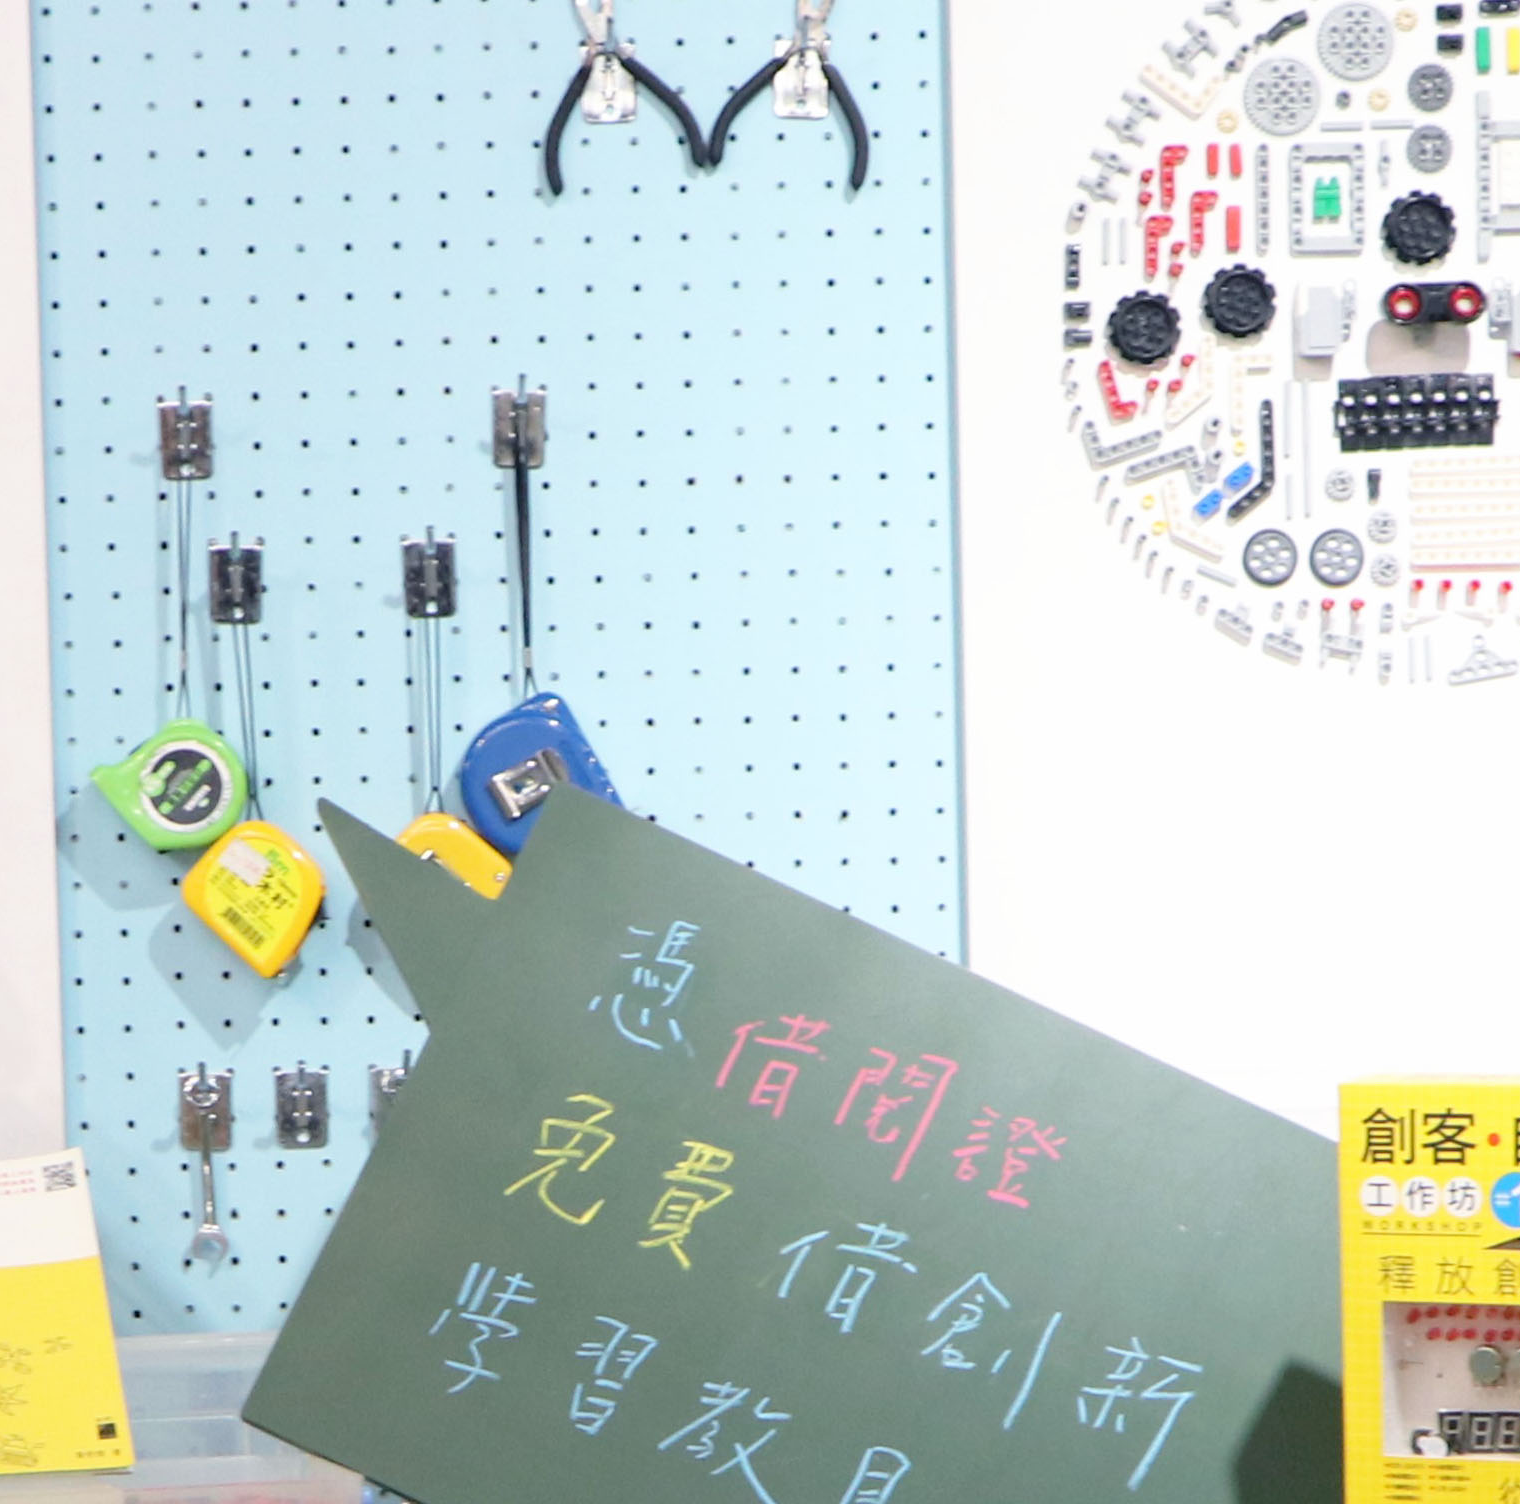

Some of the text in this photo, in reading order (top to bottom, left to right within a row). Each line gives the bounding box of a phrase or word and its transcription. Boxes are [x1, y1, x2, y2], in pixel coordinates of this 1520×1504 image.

[1365, 1181, 1478, 1213] 工作坊
[1362, 1219, 1483, 1233] WORKSHOP
[503, 1093, 1204, 1490] 免費借創新
